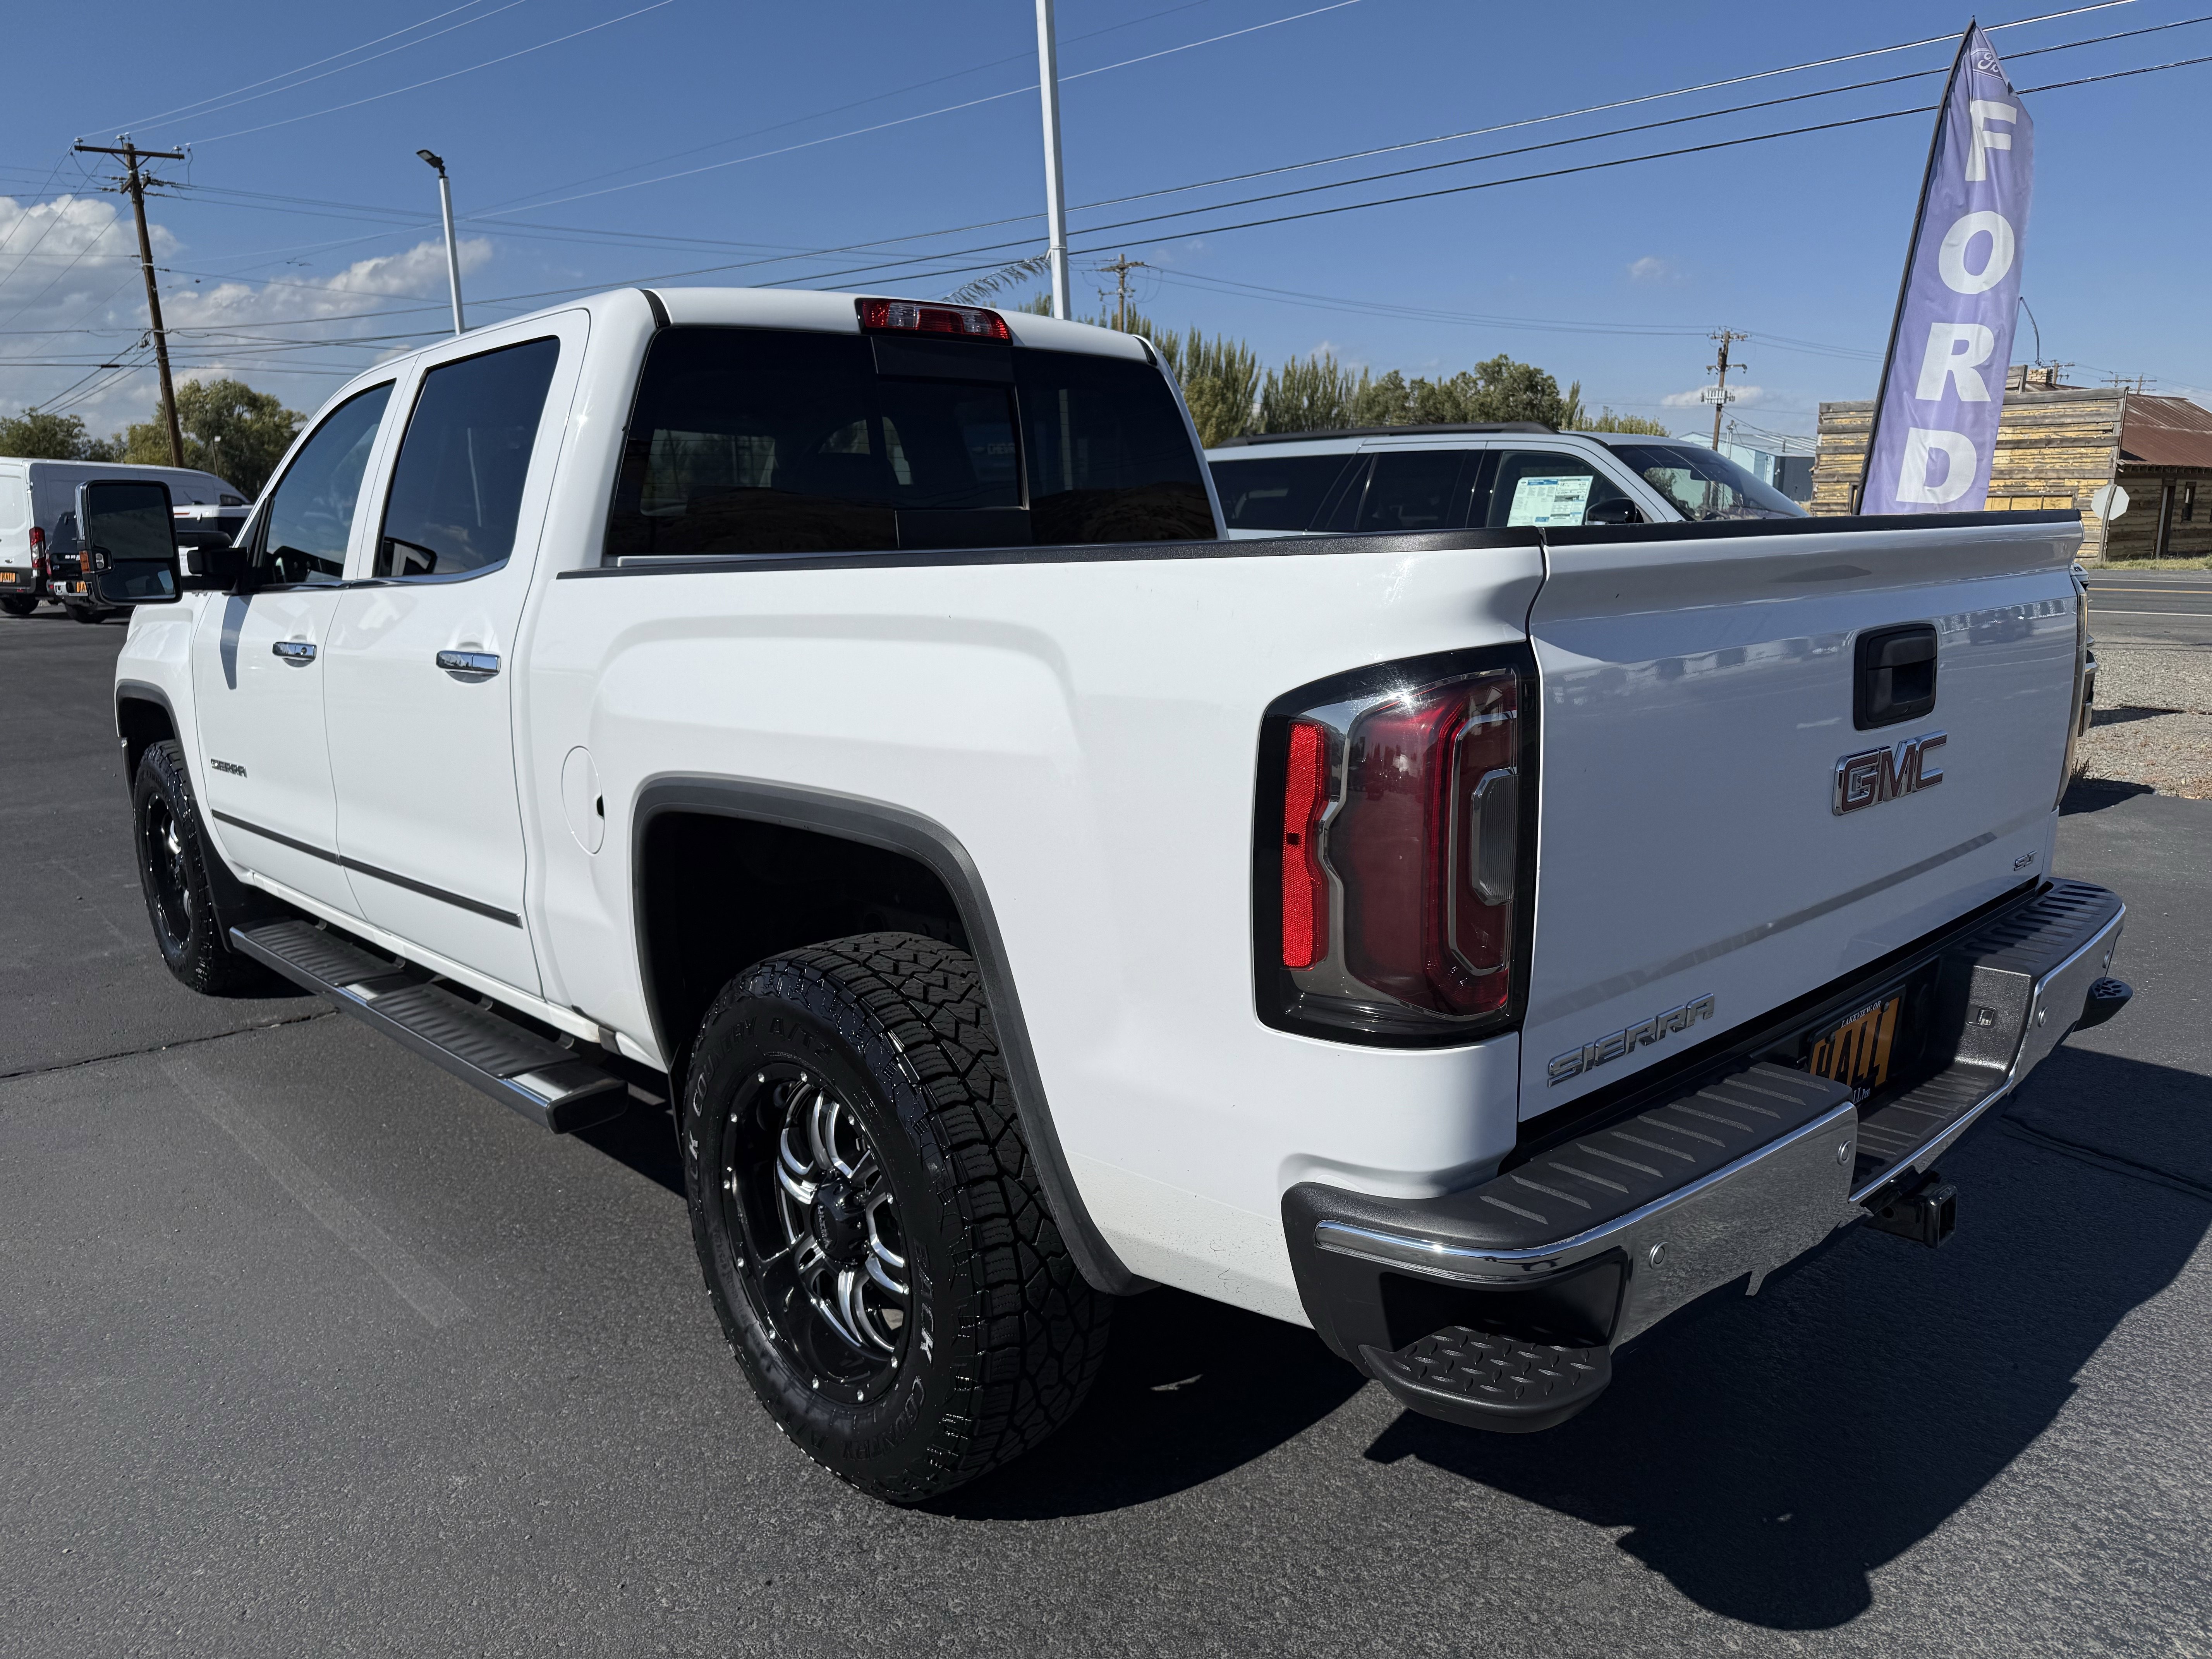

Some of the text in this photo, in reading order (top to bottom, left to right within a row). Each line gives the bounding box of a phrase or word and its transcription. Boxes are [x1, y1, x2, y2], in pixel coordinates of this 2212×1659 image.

[1896, 100, 2018, 505] FORD
[210, 758, 247, 778] SIERRA
[1832, 730, 1948, 816] GMC
[2014, 850, 2037, 871] SLT
[1547, 993, 1715, 1088] SIERRA
[1873, 1000, 1882, 1011] OR
[913, 1237, 935, 1366] BACK
[842, 1375, 926, 1462] COUNTRY
